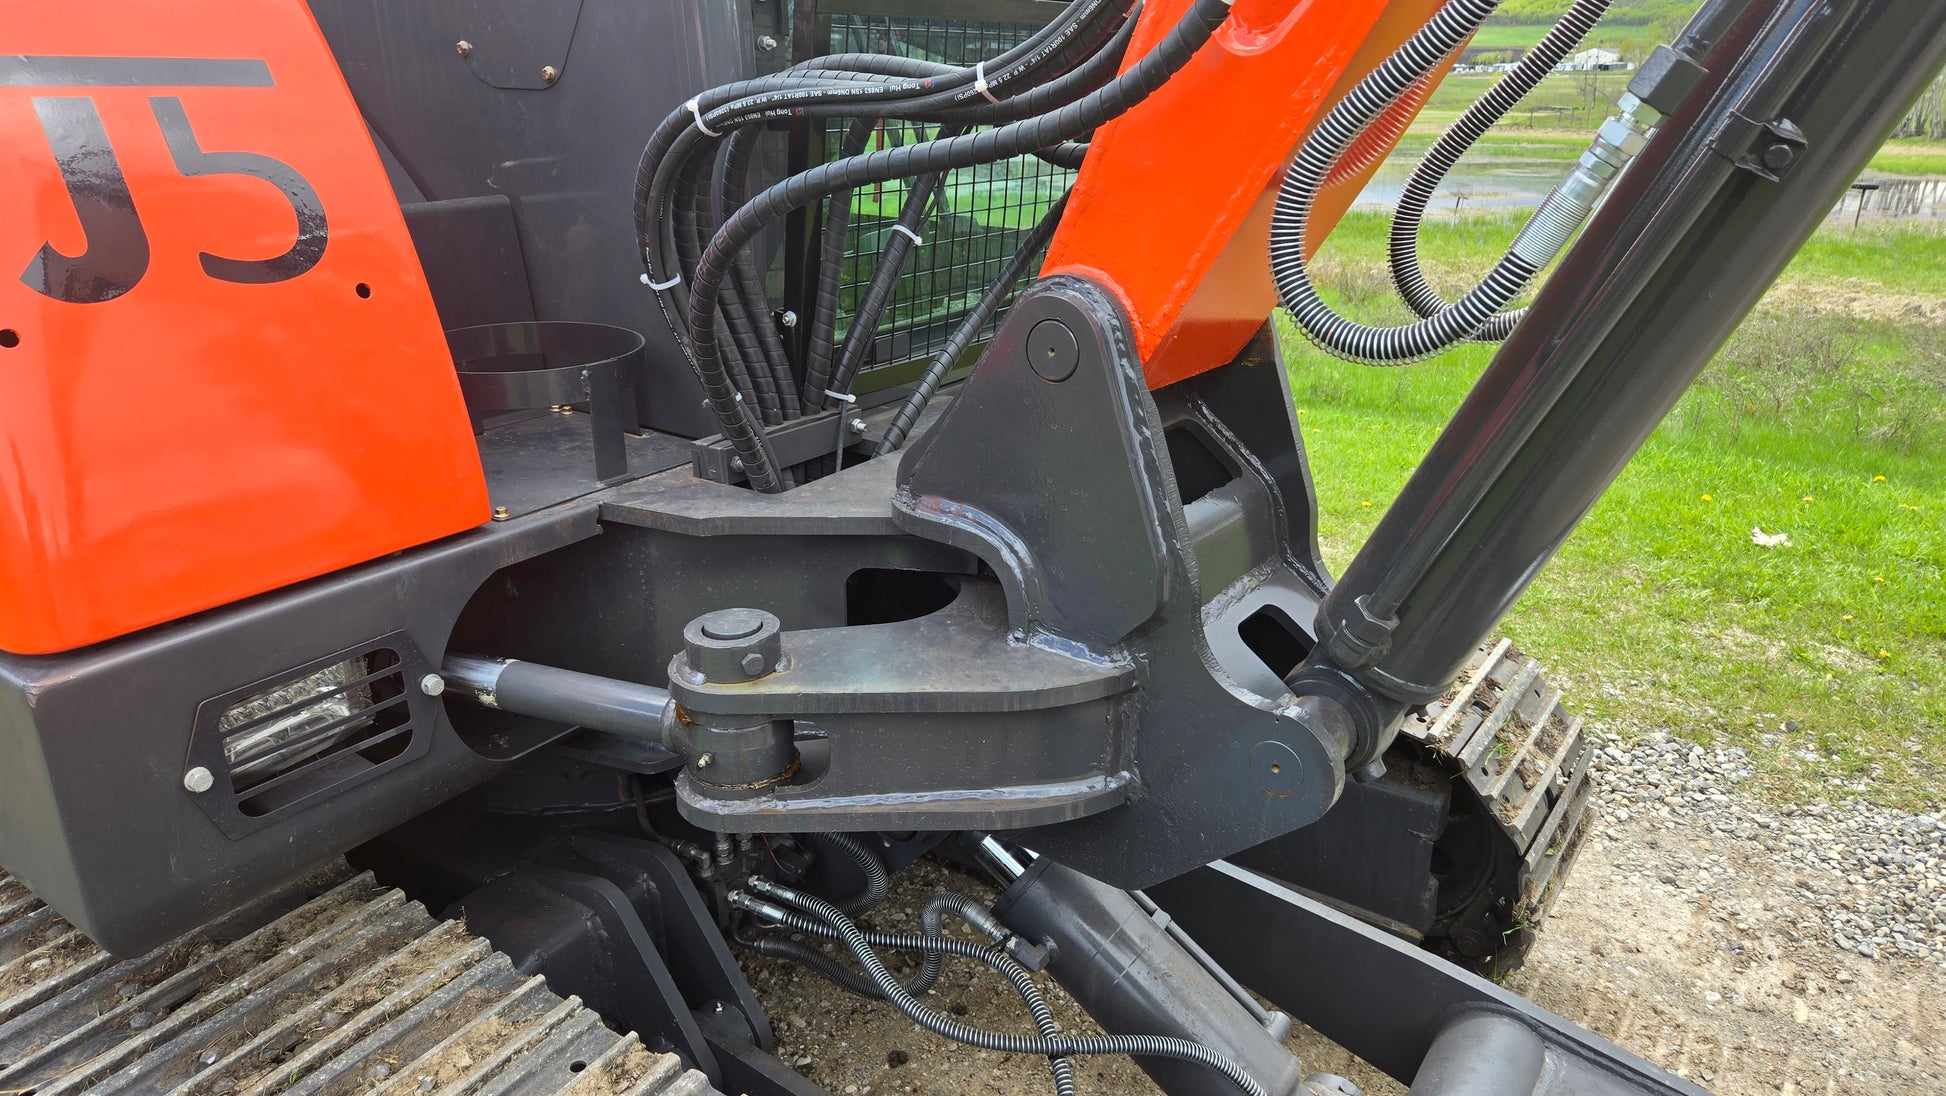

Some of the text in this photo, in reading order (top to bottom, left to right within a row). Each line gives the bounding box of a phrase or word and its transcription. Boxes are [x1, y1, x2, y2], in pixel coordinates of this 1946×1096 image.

[1064, 22, 1078, 37] SAE
[1041, 35, 1065, 57] 100R1AT
[999, 73, 1011, 83] 22.5
[863, 86, 884, 95] EN853
[889, 84, 902, 92] Hui
[903, 82, 921, 90] Tong
[784, 91, 809, 100] 100R1AT
[765, 110, 776, 118] Hui
[776, 108, 792, 116] Tong
